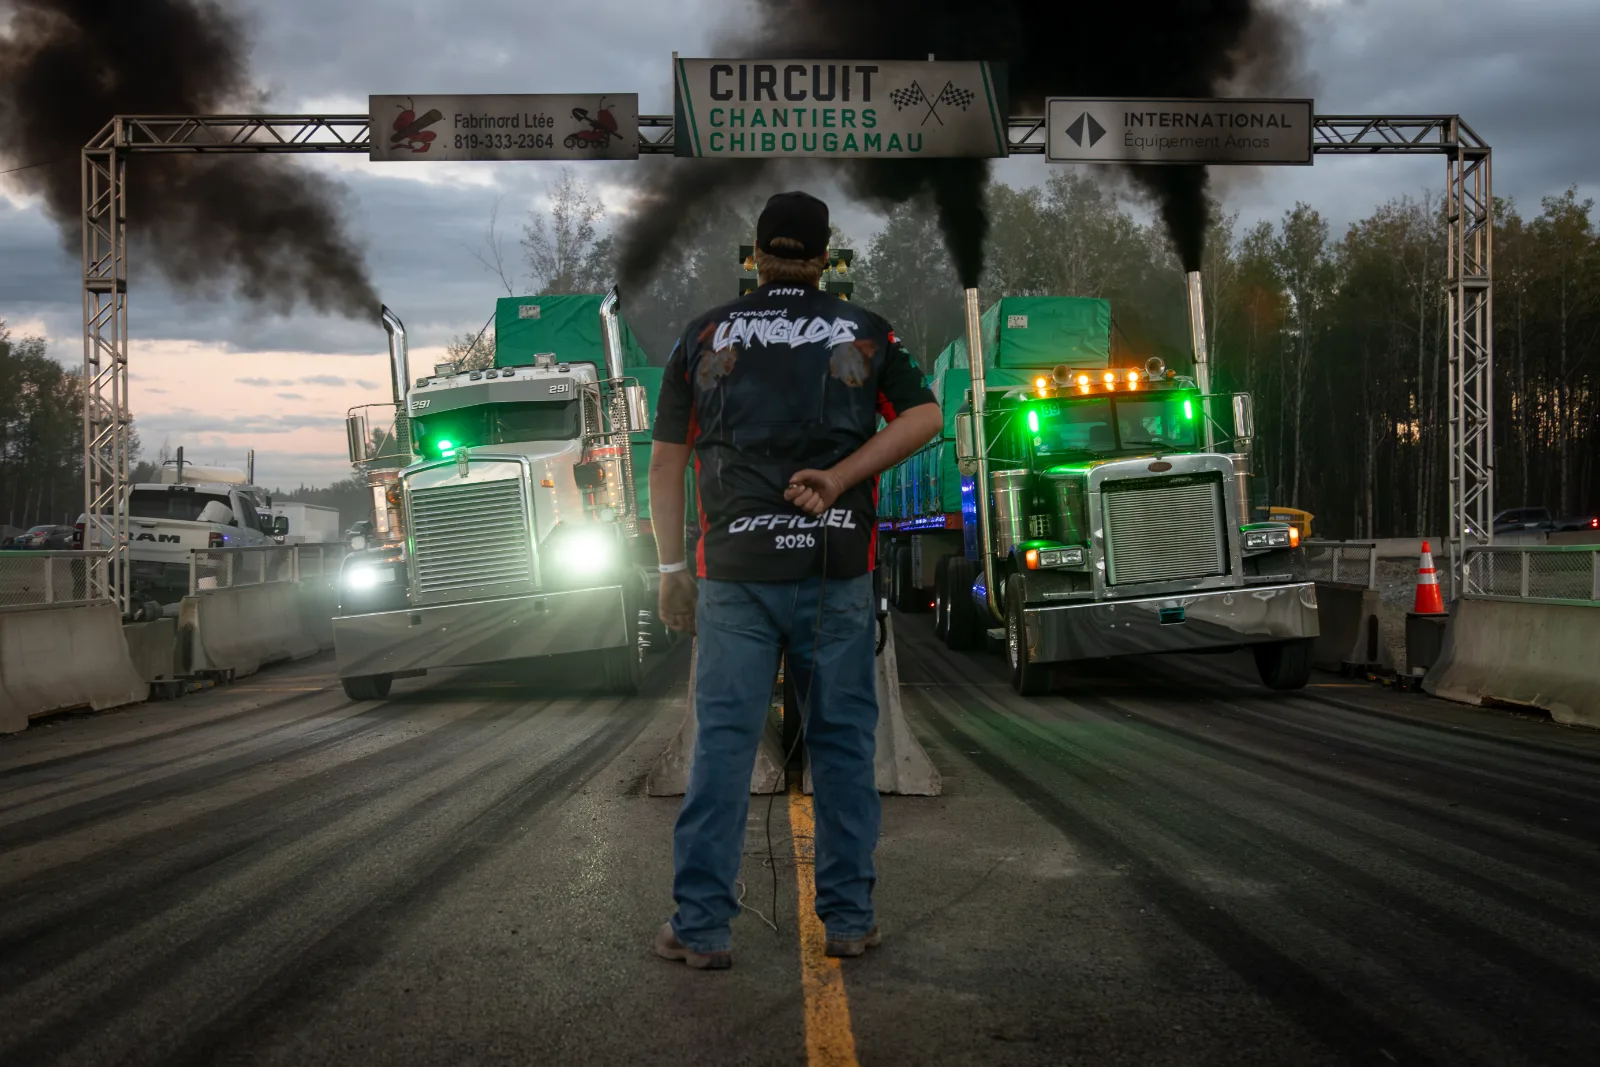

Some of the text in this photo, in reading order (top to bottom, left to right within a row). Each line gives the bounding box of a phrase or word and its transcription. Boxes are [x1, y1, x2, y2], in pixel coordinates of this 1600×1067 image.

[709, 64, 879, 102] CIRCUIT
[454, 112, 554, 129] Fabrinord Ltée
[709, 108, 877, 128] CHANTIERS
[1123, 112, 1292, 129] INTERNATIONAL
[454, 133, 554, 150] 819-333-2364
[709, 133, 923, 153] CHIBOUGAMAU
[1123, 130, 1220, 150] Équipement
[549, 383, 570, 394] 291
[411, 399, 431, 410] 291
[1043, 403, 1059, 415] 89
[774, 533, 816, 550] 2026
